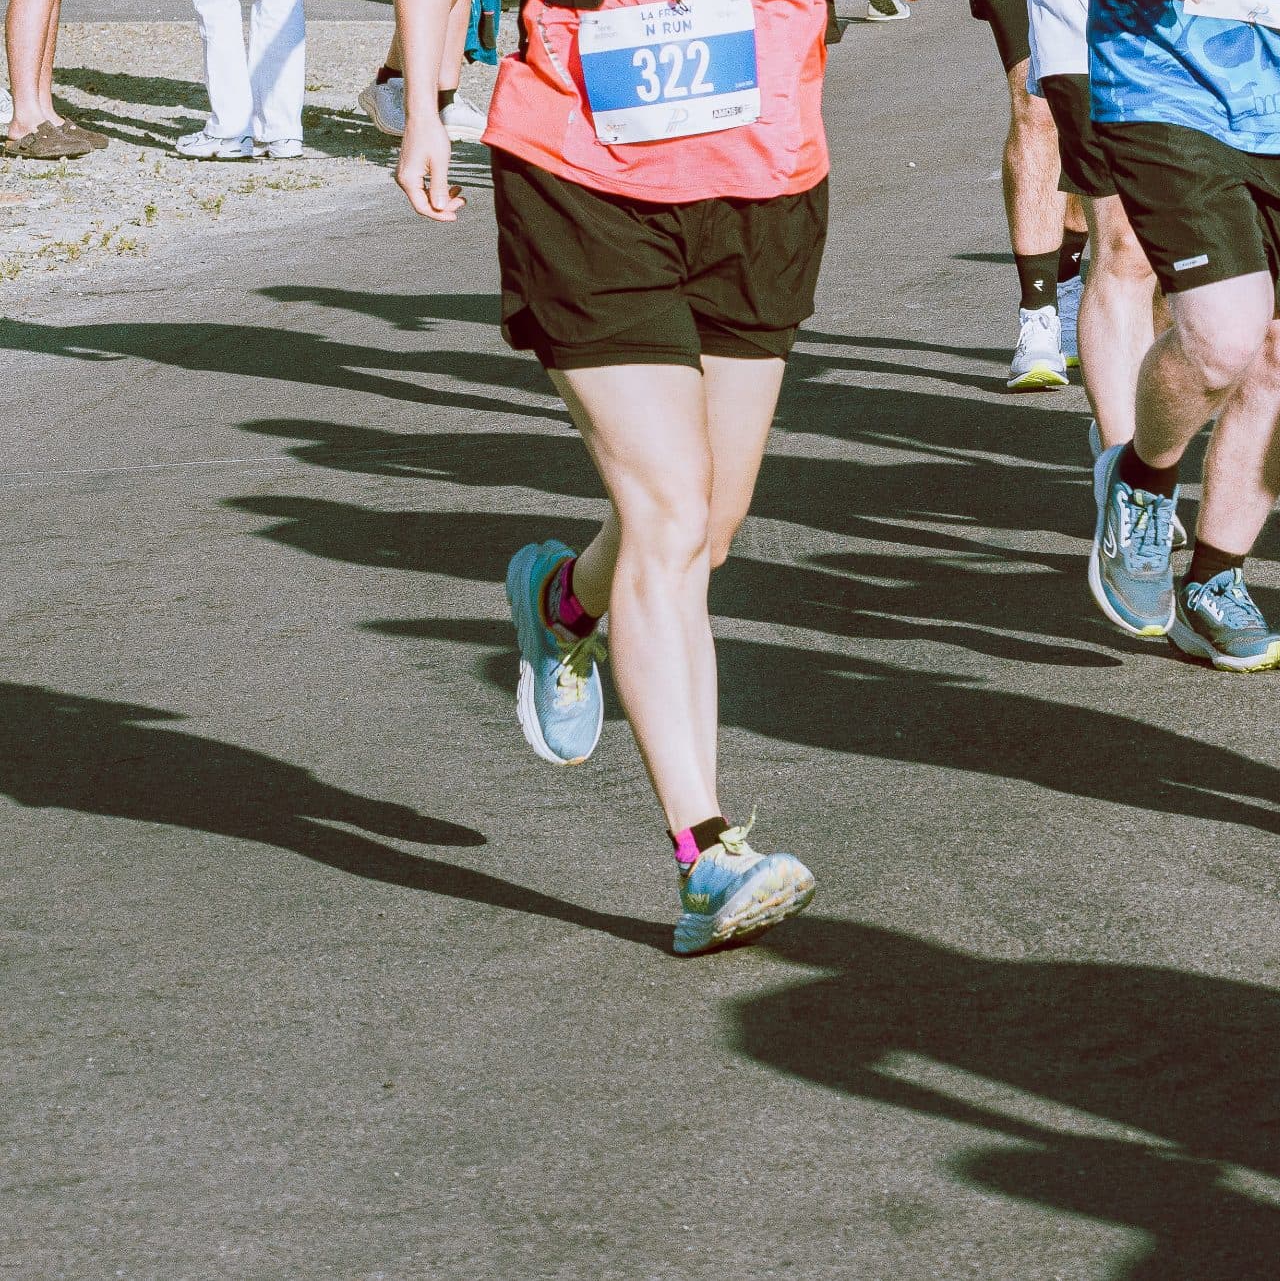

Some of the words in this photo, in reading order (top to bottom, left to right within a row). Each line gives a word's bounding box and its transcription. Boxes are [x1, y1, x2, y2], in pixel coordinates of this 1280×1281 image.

[640, 9, 654, 21] LA
[646, 24, 655, 36] N
[663, 20, 692, 34] RUN
[632, 40, 714, 103] 322
